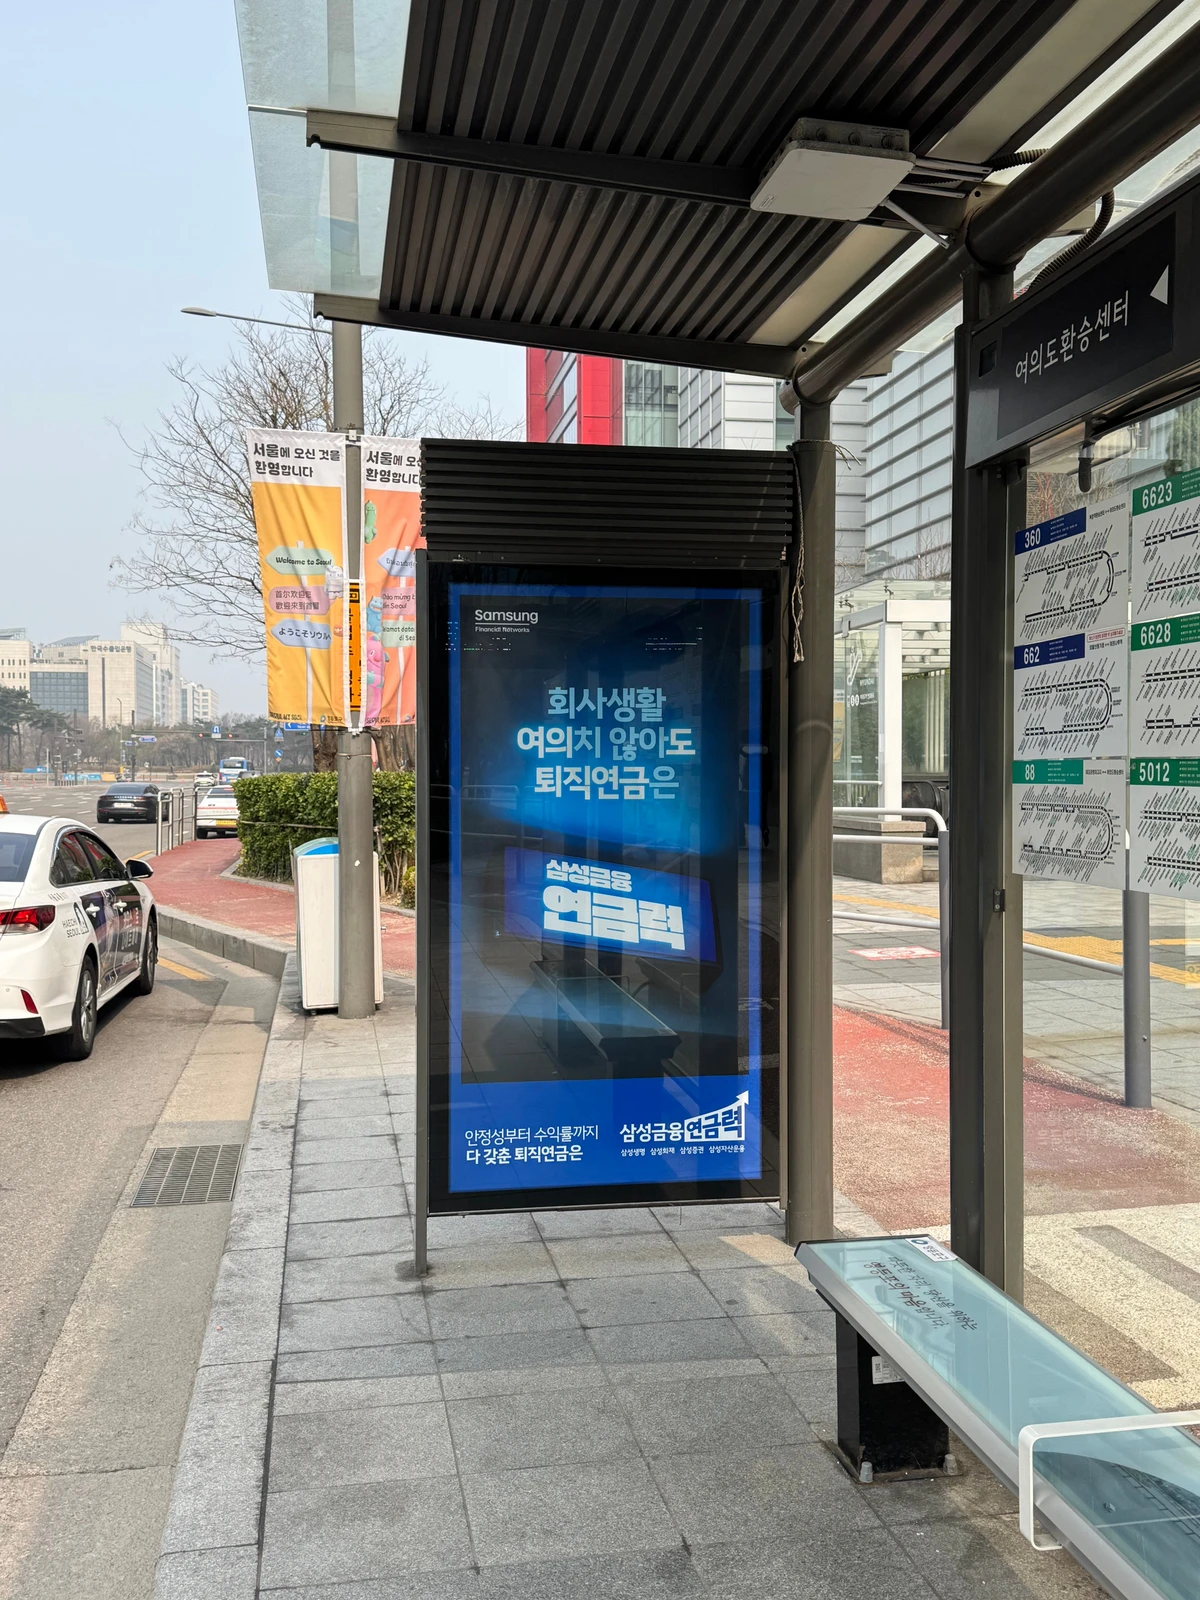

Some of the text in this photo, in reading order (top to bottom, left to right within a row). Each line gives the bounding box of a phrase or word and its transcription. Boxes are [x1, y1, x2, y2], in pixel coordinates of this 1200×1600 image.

[1015, 289, 1129, 384] 여의도환승센터
[254, 443, 341, 462] 서울에 오신 것을
[366, 450, 403, 466] 서울에
[255, 460, 314, 477] 환영합니다
[1142, 481, 1173, 509] 6623
[1025, 528, 1041, 549] 360
[275, 557, 306, 565] Welcome
[315, 558, 332, 566] Seoul
[474, 609, 539, 625] Samsung
[1140, 622, 1171, 646] 6628
[1023, 646, 1040, 665] 662
[547, 687, 666, 723] 회사생활
[516, 726, 696, 761] 여의치 않아도
[534, 765, 680, 800] 퇴직연금은
[1025, 764, 1035, 780] 88
[1139, 762, 1170, 782] 5012
[546, 859, 632, 893] 삼성금융
[542, 885, 686, 951] 연금력
[465, 1124, 599, 1147] 안정성부터 수익률까지
[619, 1122, 684, 1143] 삼성금융
[466, 1144, 583, 1165] 다 갖춘 퇴직연금은
[620, 1144, 745, 1157] 삼성생명 삼성화재 삼성증권 삼성자산운용
[863, 1261, 910, 1290] 영등포의
